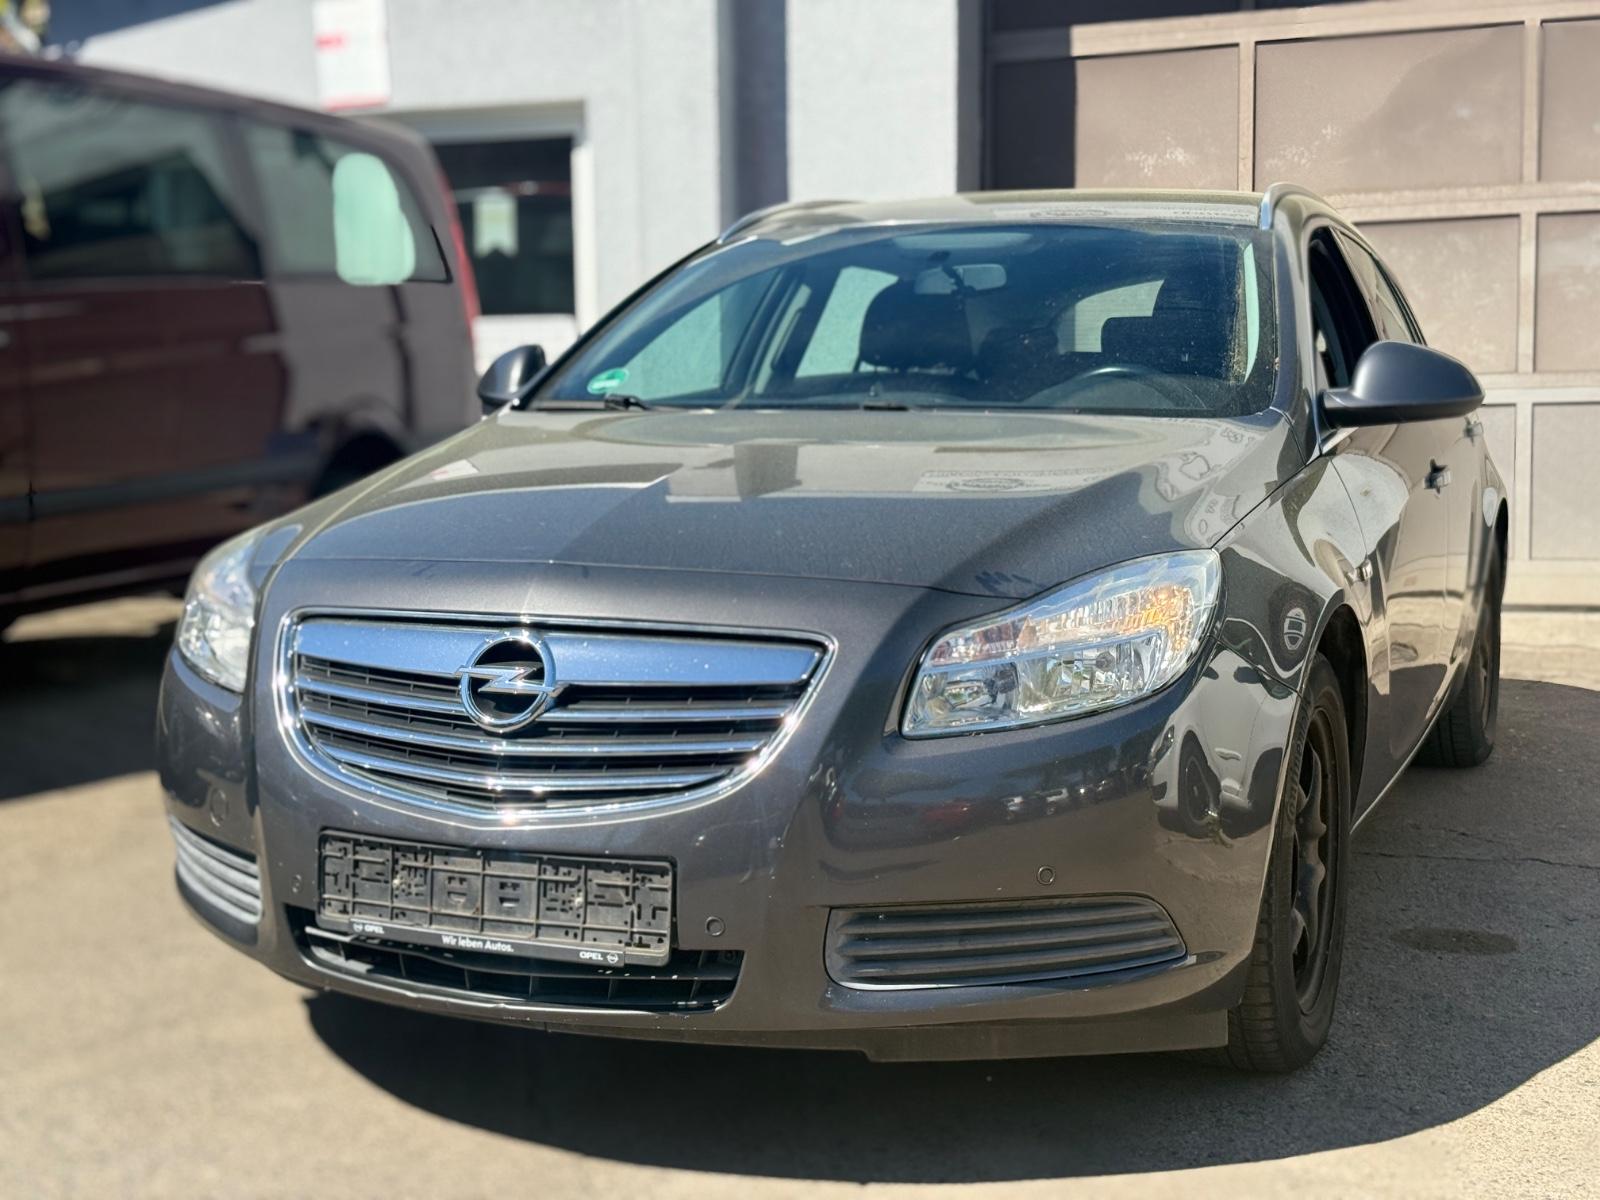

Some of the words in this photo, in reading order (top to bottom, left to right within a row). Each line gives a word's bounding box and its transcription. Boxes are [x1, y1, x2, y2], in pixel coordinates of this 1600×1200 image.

[364, 924, 385, 934] OPEL
[441, 935, 457, 945] Wir
[458, 936, 483, 949] leben
[485, 940, 514, 953] Autos.
[579, 951, 603, 961] OPEL
